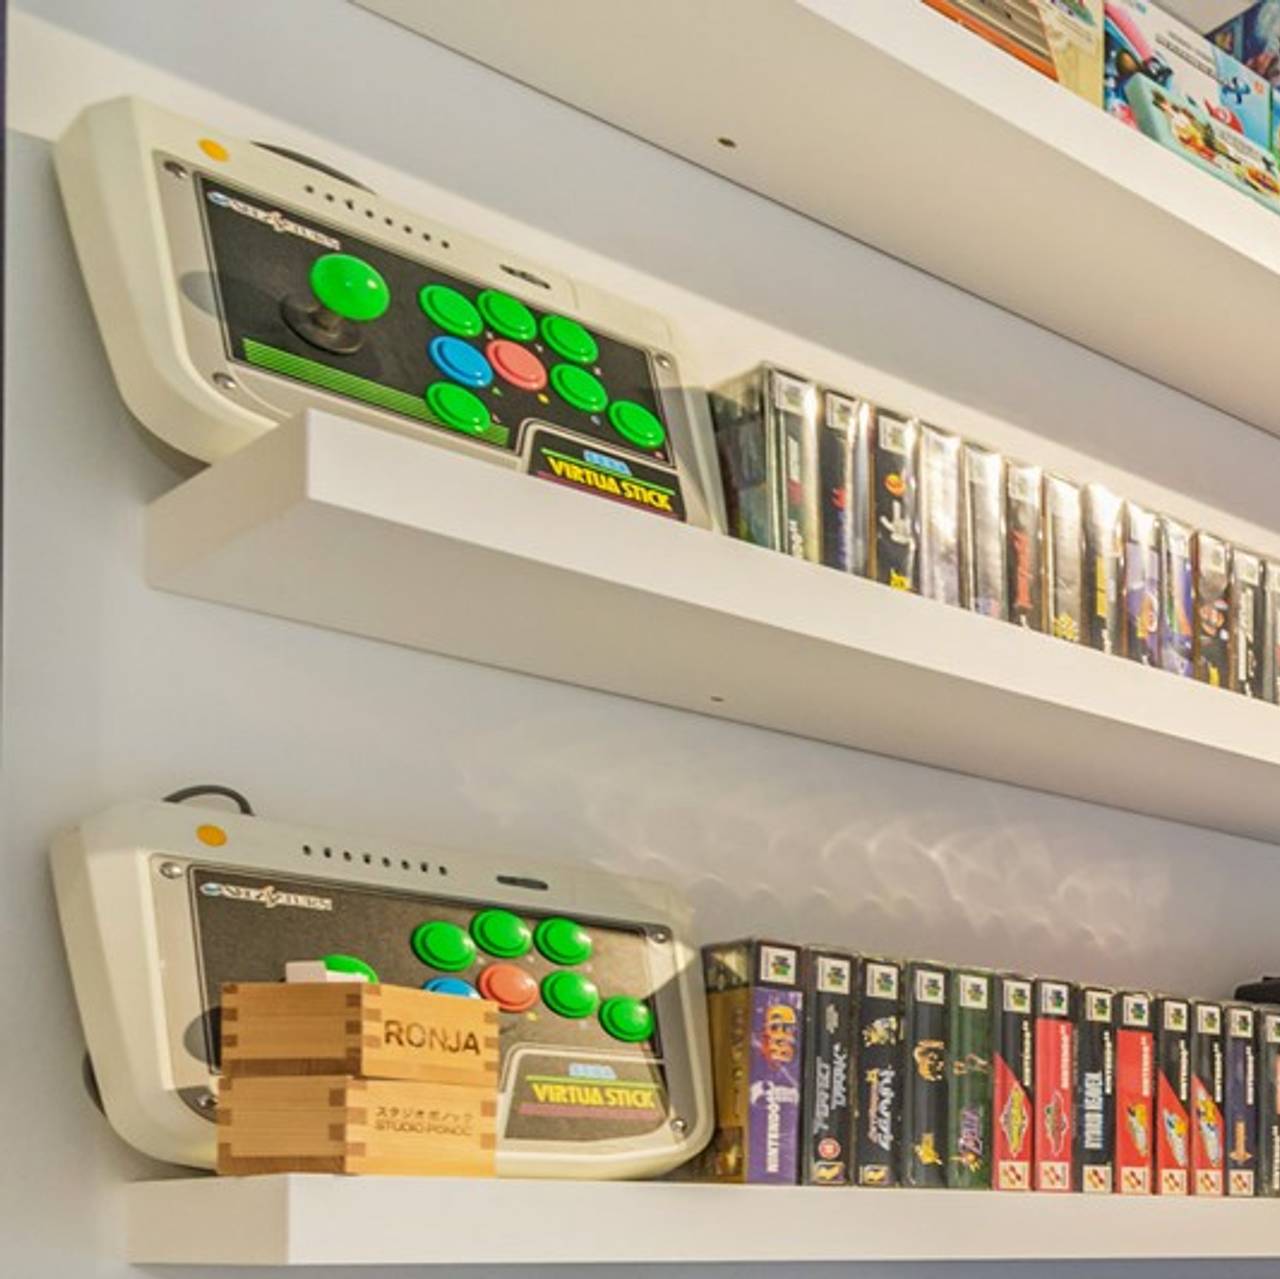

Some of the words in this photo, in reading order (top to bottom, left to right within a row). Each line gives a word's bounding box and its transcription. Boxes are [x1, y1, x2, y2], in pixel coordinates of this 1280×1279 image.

[546, 456, 622, 496] VIRTUA
[620, 480, 673, 512] STICK
[384, 1020, 481, 1055] RONJA
[532, 1083, 605, 1107] VIRTUA
[605, 1088, 656, 1110] STICK
[813, 1056, 831, 1135] PERFECT
[832, 1049, 848, 1111] DARK
[374, 1119, 424, 1134] STUDIO
[766, 1103, 780, 1173] NINTENDO
